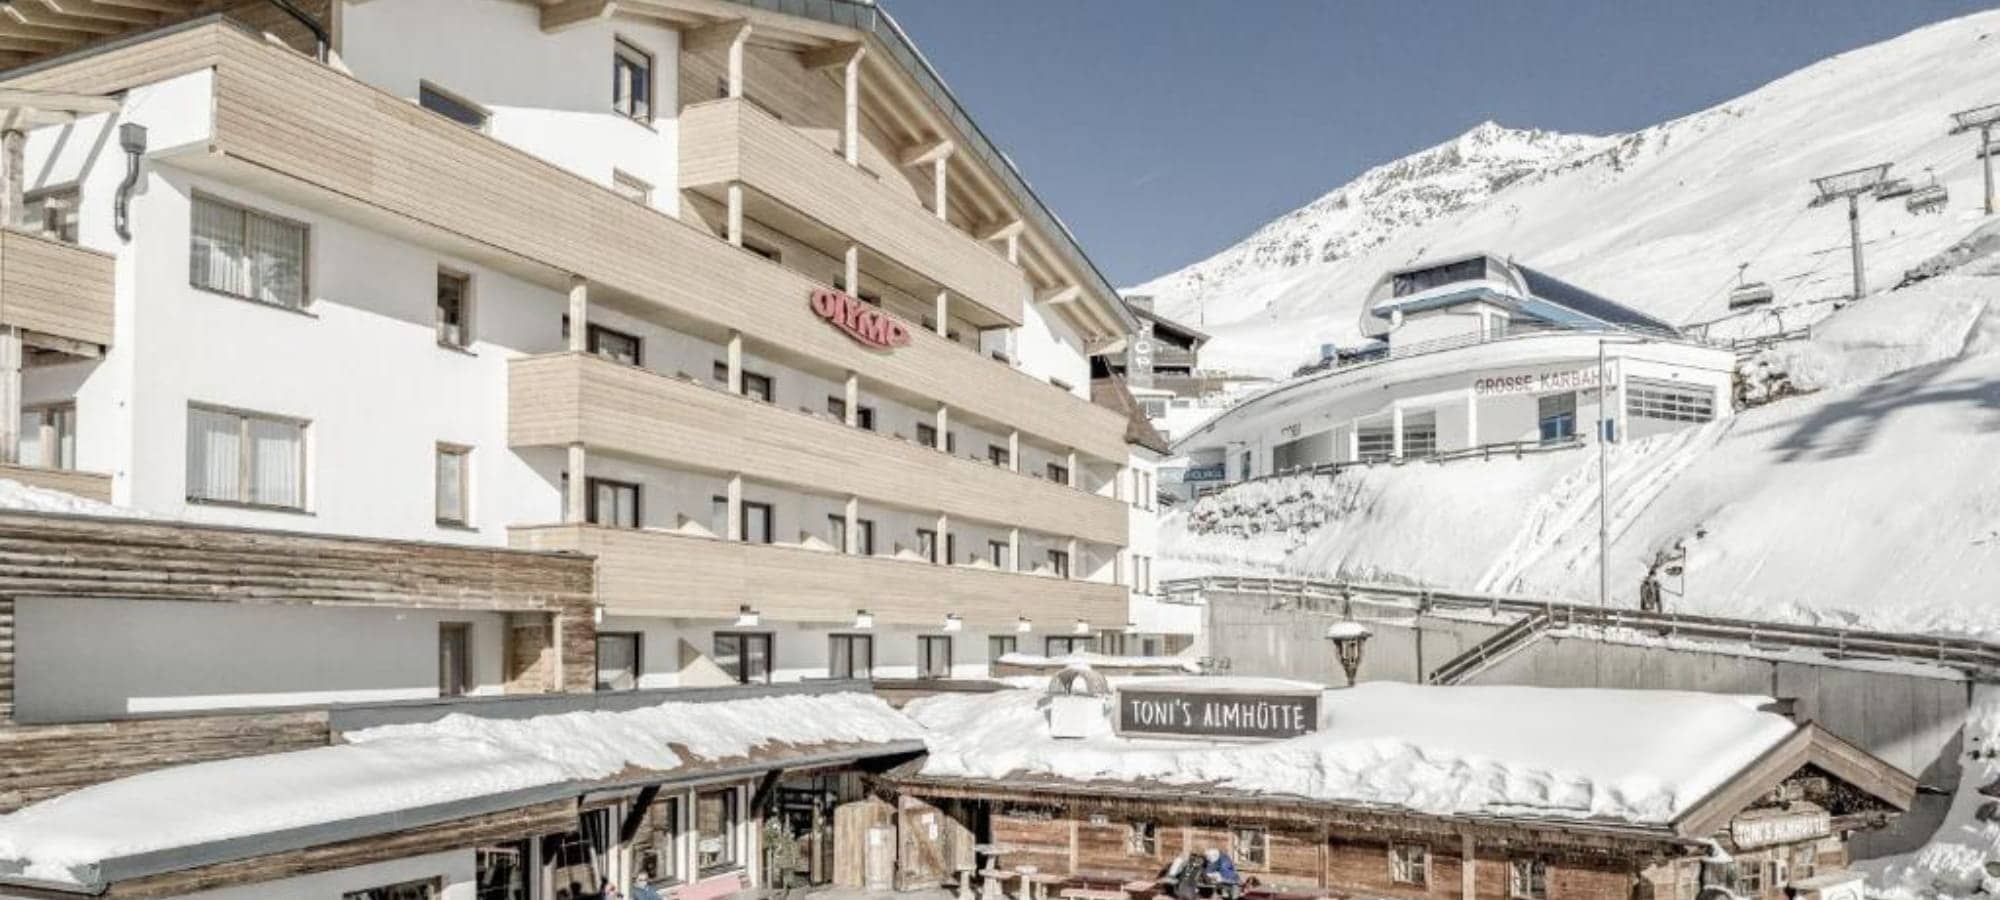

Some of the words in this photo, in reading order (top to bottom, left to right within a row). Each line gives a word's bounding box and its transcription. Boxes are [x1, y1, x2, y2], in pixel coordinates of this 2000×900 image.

[810, 289, 911, 350] OLYMP
[1475, 374, 1532, 395] GROSSE
[1131, 699, 1191, 727] TONI'S
[1204, 702, 1306, 730] ALMHÜTTE
